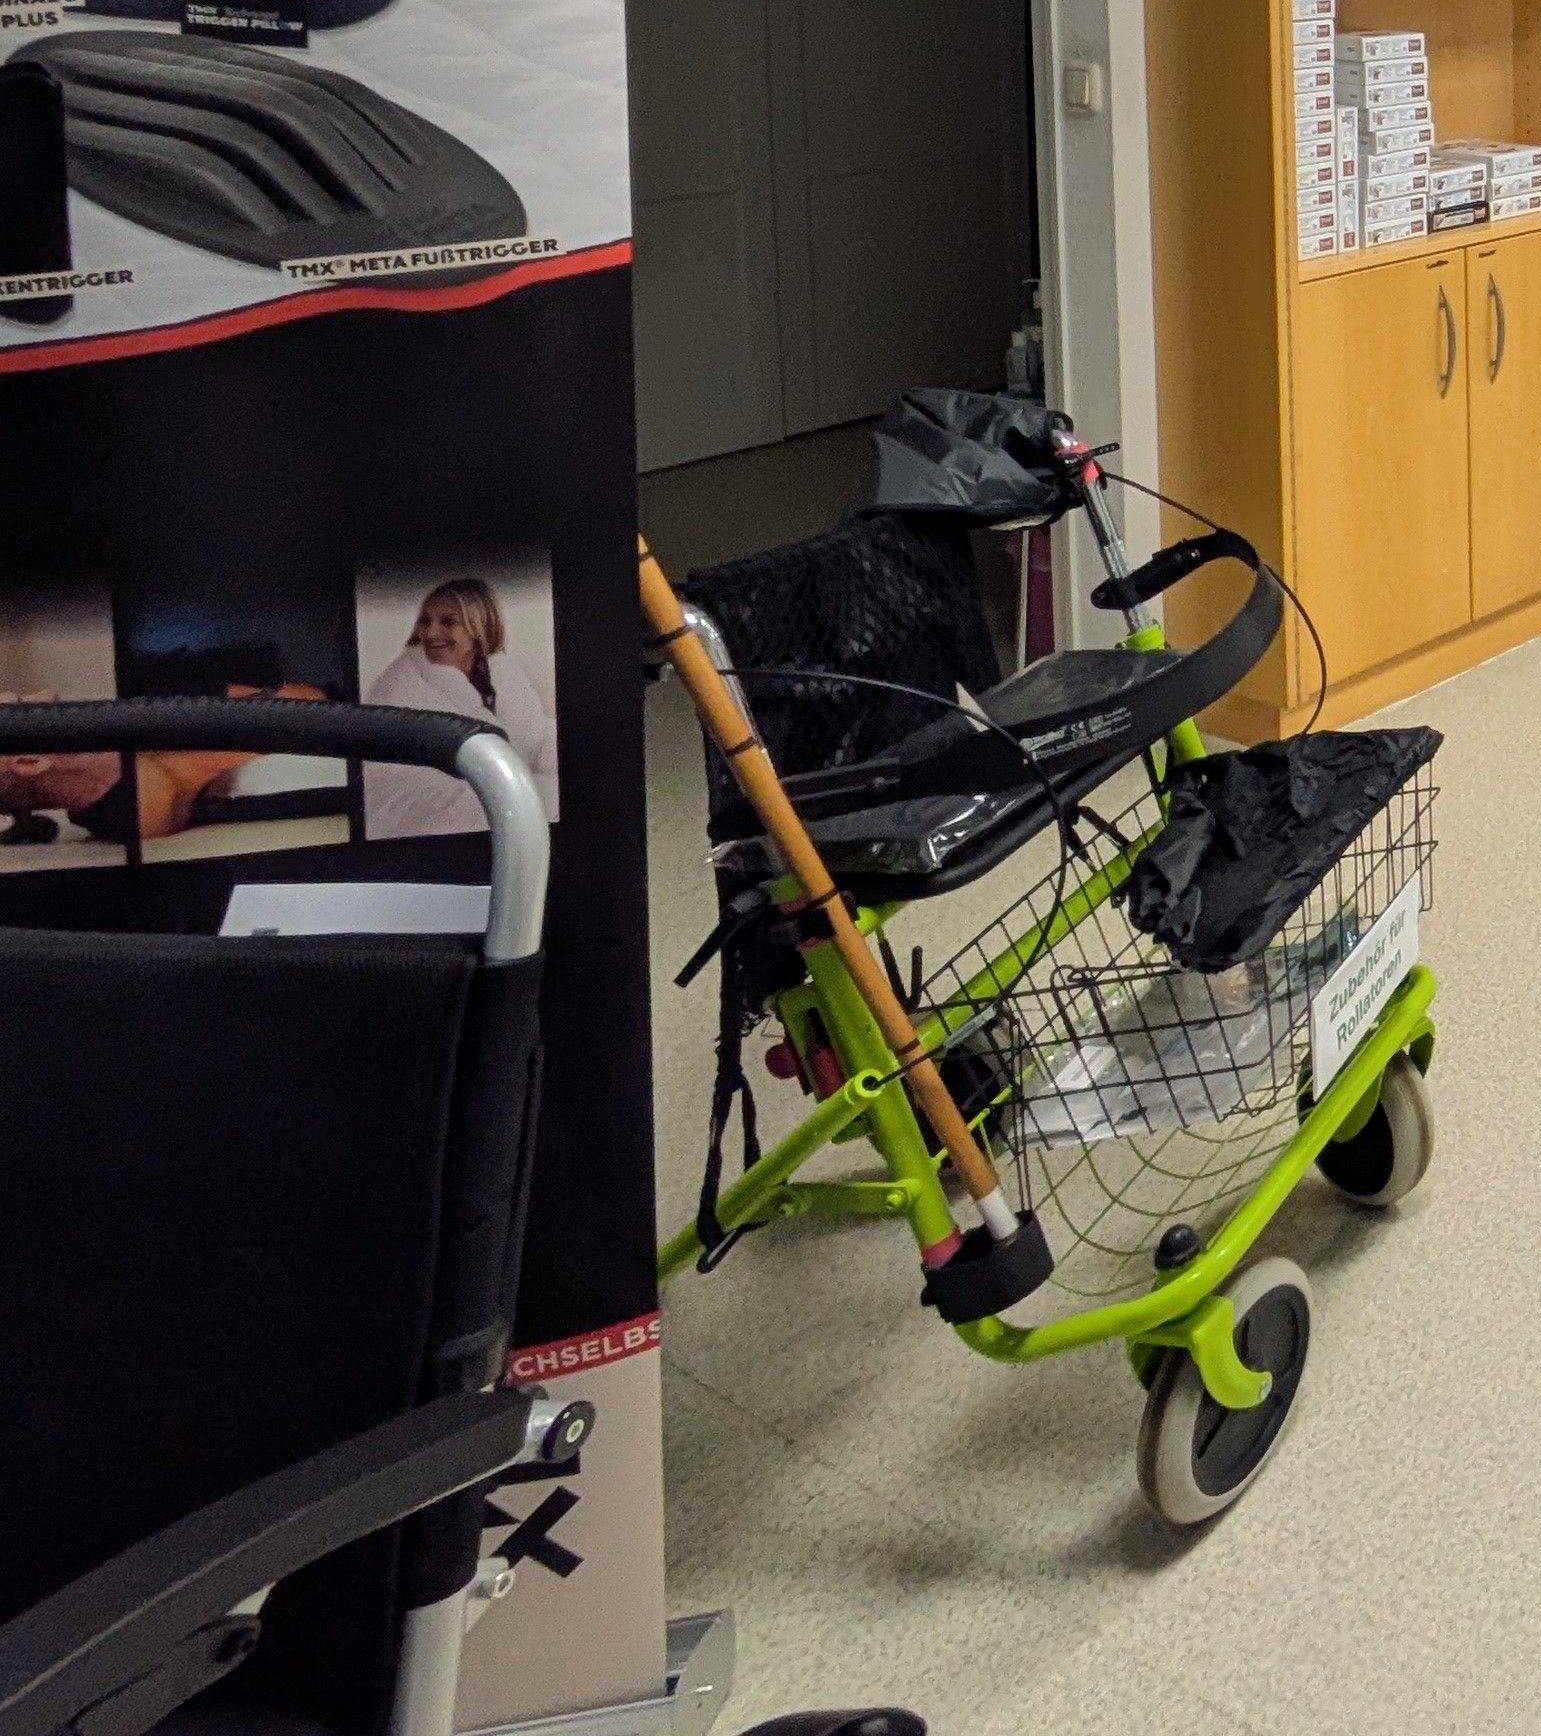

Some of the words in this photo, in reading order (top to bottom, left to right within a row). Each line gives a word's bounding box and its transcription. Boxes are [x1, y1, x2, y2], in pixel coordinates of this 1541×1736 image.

[1, 11, 59, 28] PLUS
[350, 257, 406, 275] META
[1328, 937, 1387, 1023] Zubehör
[1389, 907, 1407, 945] für
[1336, 947, 1403, 1052] Rollatoren
